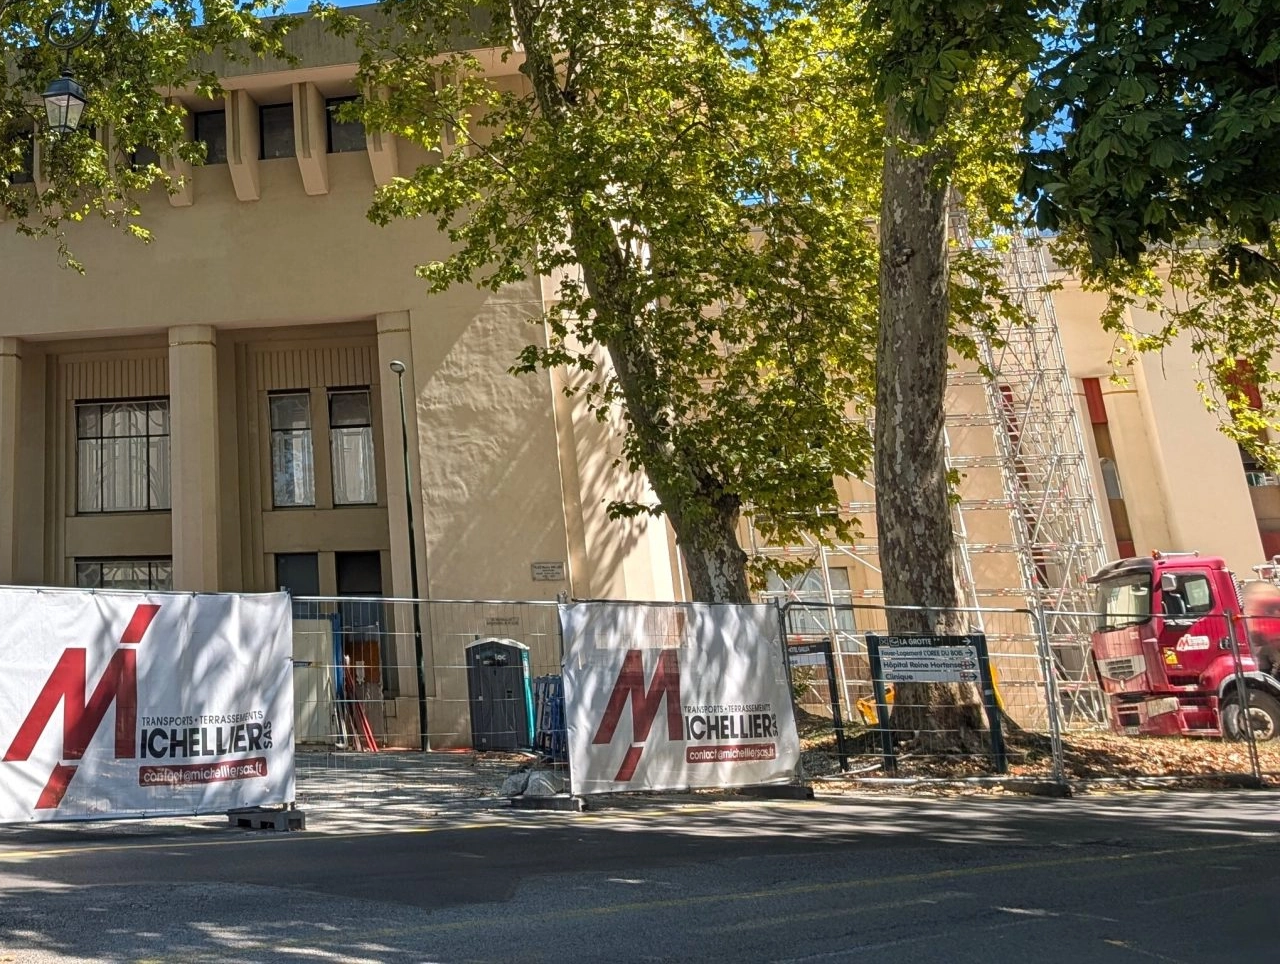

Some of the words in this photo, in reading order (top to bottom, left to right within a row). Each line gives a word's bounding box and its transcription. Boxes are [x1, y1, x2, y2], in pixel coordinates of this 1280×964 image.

[883, 660, 908, 669] Hôpital
[885, 672, 914, 681] Clinique
[683, 705, 724, 714] TRANSPORTS
[727, 703, 771, 713] TERRASSEMENTS
[141, 715, 193, 727] TRANSPORTS
[199, 710, 264, 725] TERRASSEMENTS
[263, 720, 274, 750] SAS
[143, 760, 264, 783] contact@michelliersas.fr
